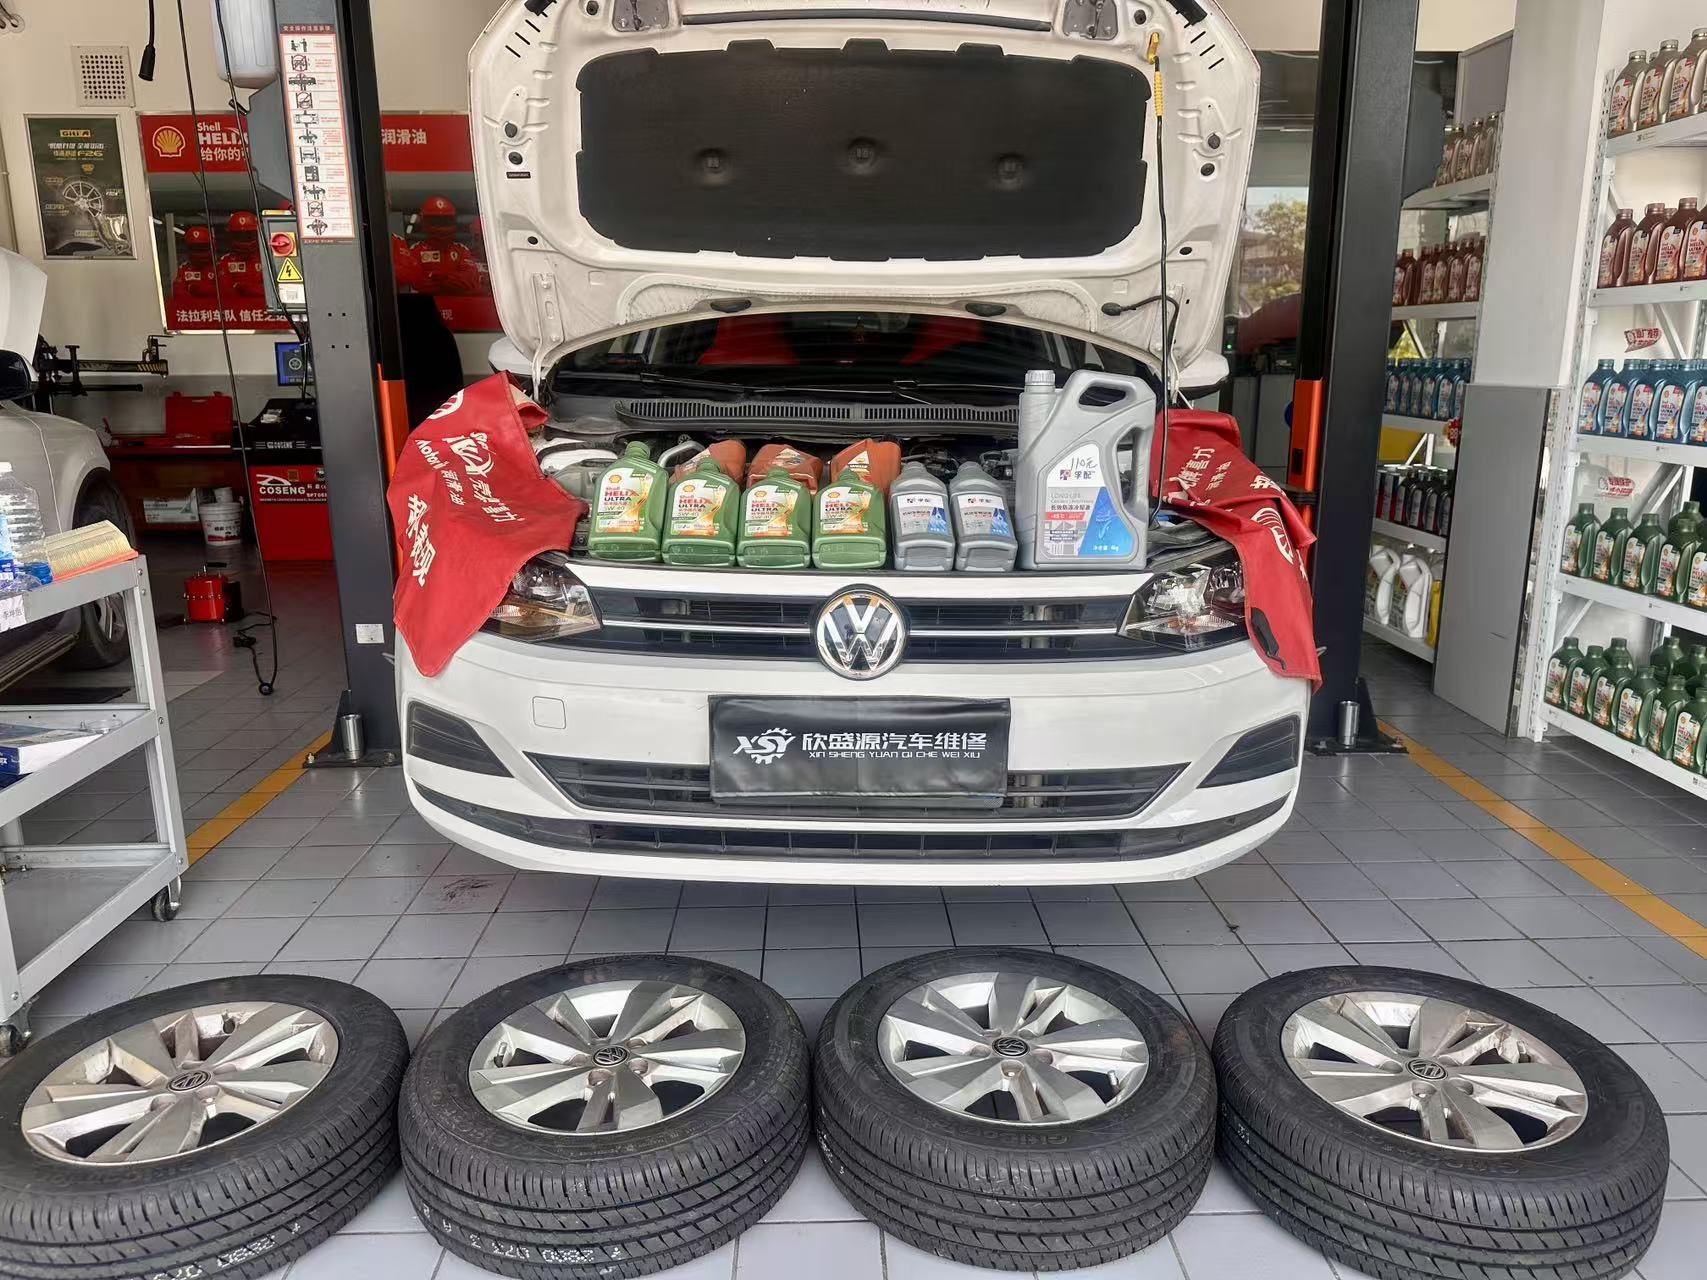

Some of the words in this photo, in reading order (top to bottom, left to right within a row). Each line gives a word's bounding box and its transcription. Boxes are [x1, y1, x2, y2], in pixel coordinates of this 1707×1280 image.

[197, 122, 221, 131] Shell
[381, 128, 427, 145] 润滑油
[176, 309, 237, 322] 法拉利车队
[259, 486, 305, 495] COSENG
[733, 735, 796, 755] XSY
[802, 732, 987, 751] 欣盛源汽车维修
[809, 751, 826, 759] XIN
[829, 751, 865, 759] SHENG
[869, 751, 899, 759] YUAN
[901, 751, 914, 759] QI
[916, 751, 938, 759] CHE
[942, 751, 960, 759] WEI
[963, 751, 981, 759] XIU
